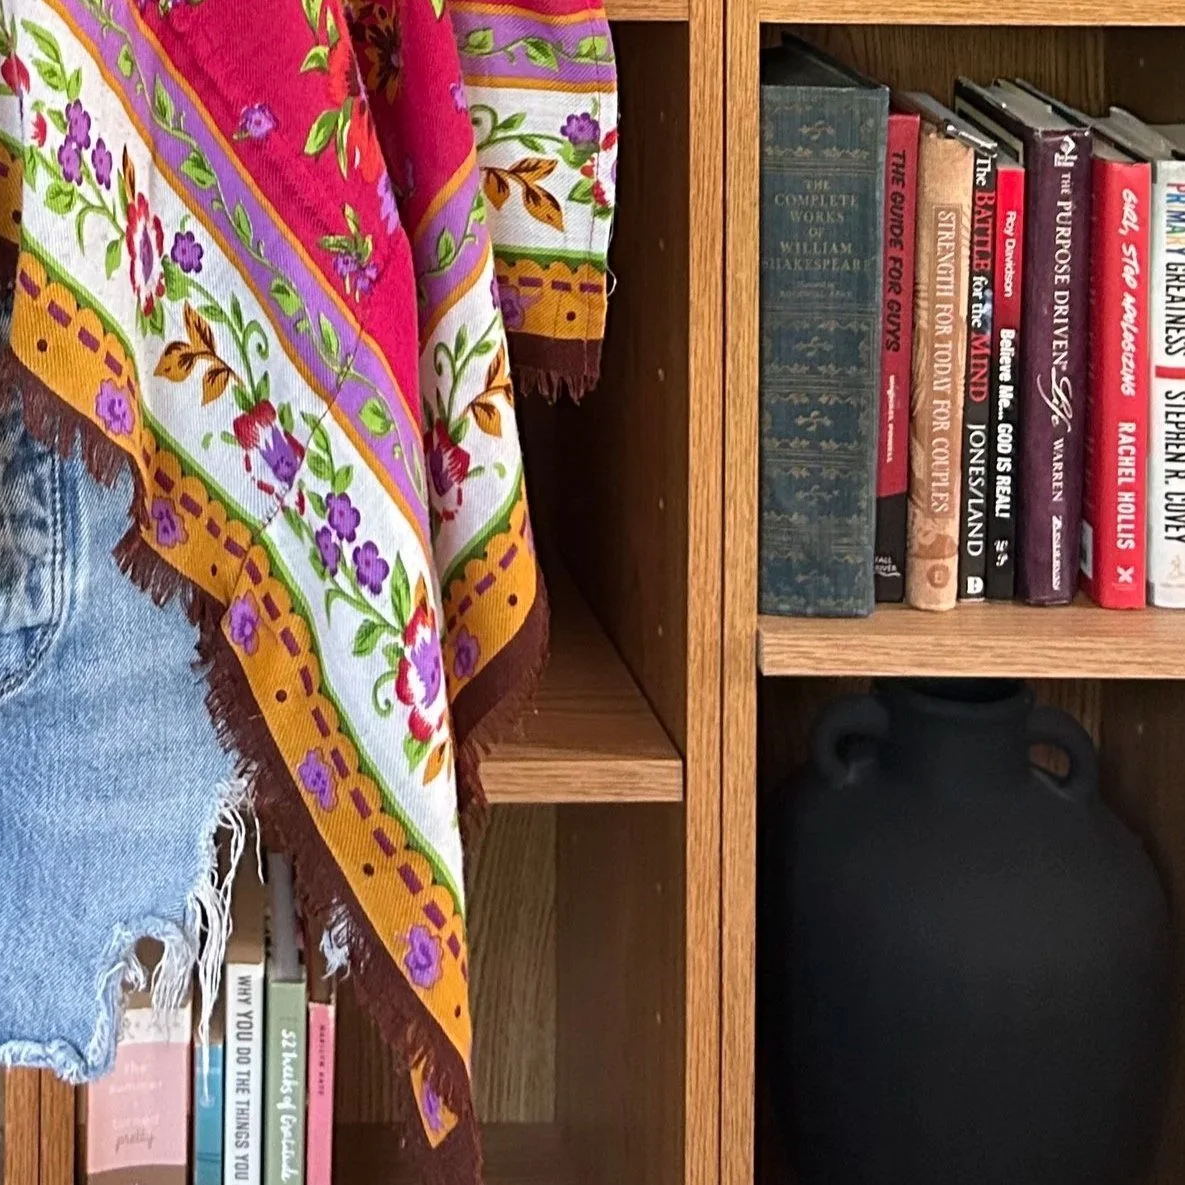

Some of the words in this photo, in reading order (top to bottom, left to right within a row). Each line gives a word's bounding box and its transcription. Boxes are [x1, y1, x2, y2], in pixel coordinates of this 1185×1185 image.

[891, 149, 906, 187] THE
[976, 157, 992, 186] The
[1060, 172, 1072, 196] THE
[775, 194, 858, 207] COMPLETE
[790, 210, 844, 223] WORKS
[889, 191, 905, 251] GUIDE
[973, 190, 996, 272] BATTLE
[1003, 211, 1017, 236] Roy
[780, 241, 853, 254] WILLIAM
[935, 211, 956, 297] STRENGTH
[1054, 200, 1073, 285] PURPOSE
[887, 256, 903, 295] FOR
[1003, 237, 1015, 298] Davidson
[972, 276, 988, 299] for
[886, 298, 901, 352] GUYS
[934, 303, 954, 337] FOR
[971, 303, 990, 328] the
[1052, 290, 1070, 366] DRIVEN
[932, 340, 953, 394] TODAY
[969, 331, 992, 402] MIND
[999, 329, 1016, 382] Believe
[932, 399, 951, 433] FOR
[998, 384, 1014, 420] Me...
[997, 423, 1013, 454] GOD
[1117, 422, 1136, 486] RACHEL
[930, 437, 950, 514] COUPLES
[996, 456, 1012, 472] IS
[1052, 437, 1064, 502] WARREN
[966, 424, 986, 556] JONES/LAND
[995, 474, 1011, 519] REAL!
[1116, 491, 1136, 550] HOLLIS
[237, 975, 252, 1005] WHY
[236, 1010, 254, 1042] YOU
[236, 1047, 251, 1065] DO
[236, 1069, 250, 1094] THE
[276, 1096, 297, 1110] of
[115, 1128, 155, 1154] pretty
[235, 1099, 250, 1149] THINGS
[234, 1153, 249, 1181] YOU
